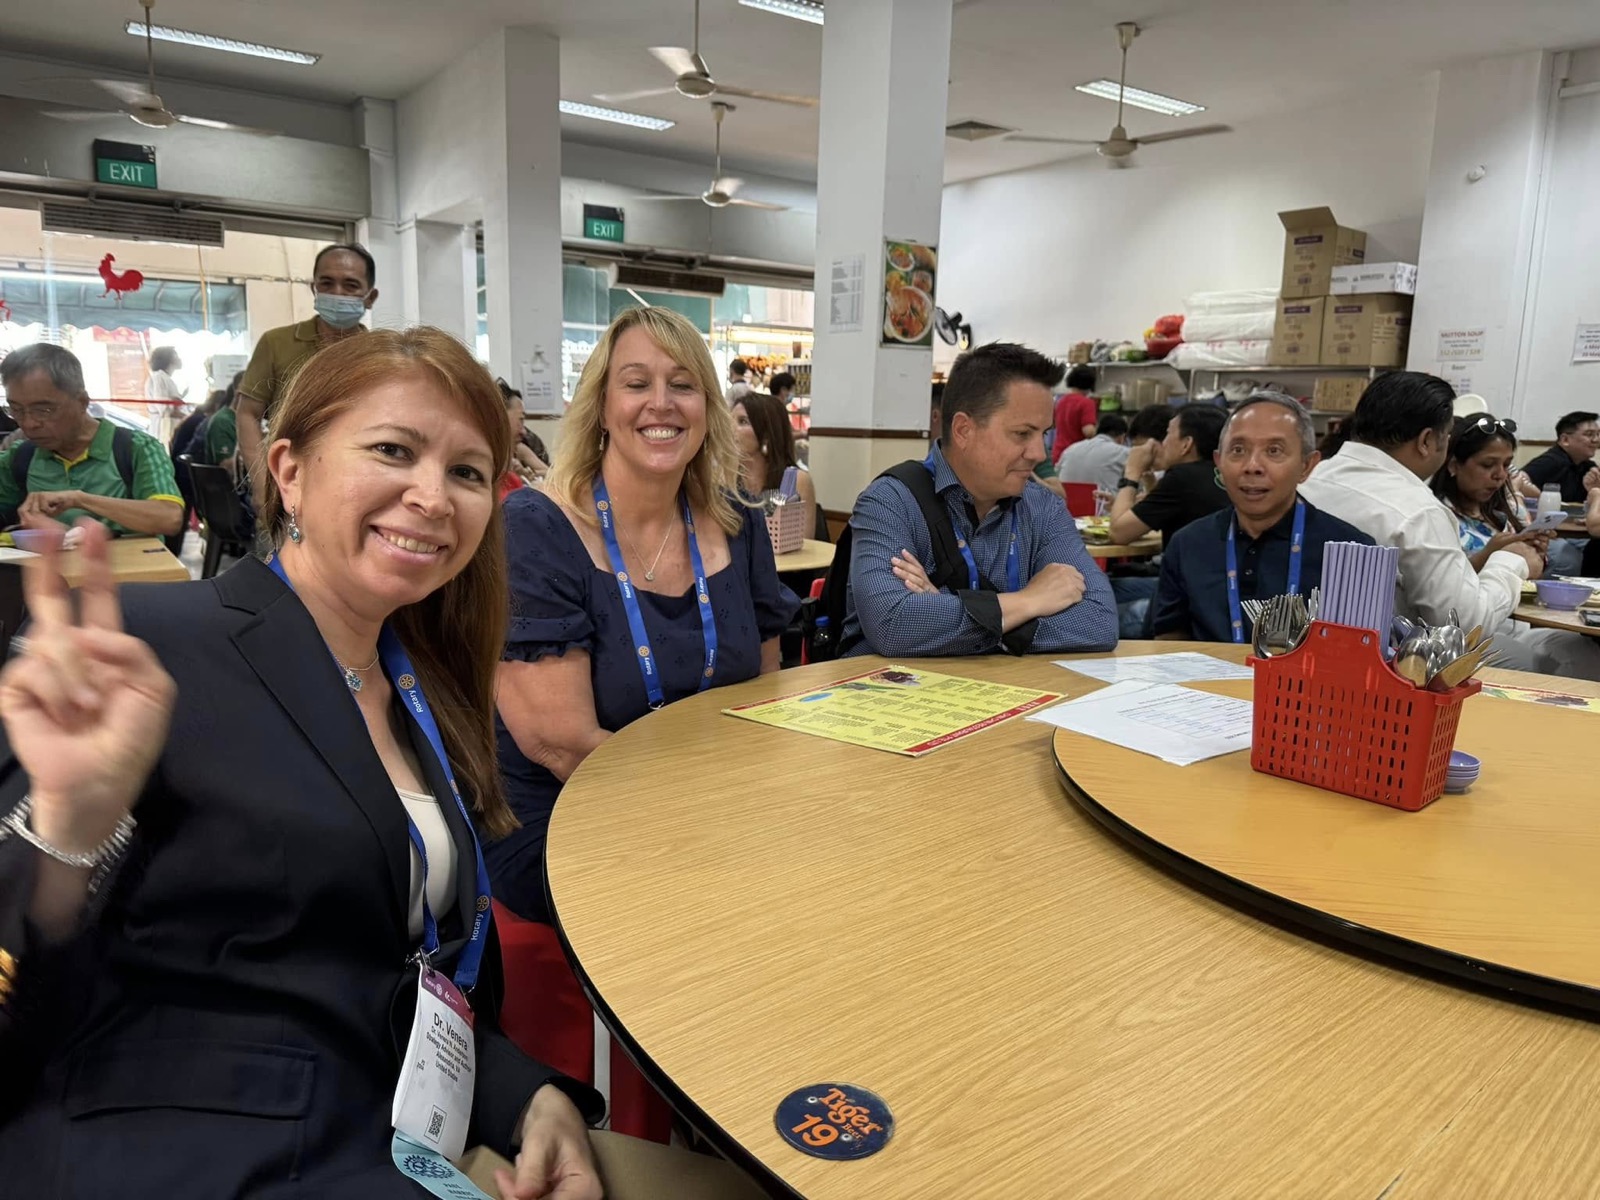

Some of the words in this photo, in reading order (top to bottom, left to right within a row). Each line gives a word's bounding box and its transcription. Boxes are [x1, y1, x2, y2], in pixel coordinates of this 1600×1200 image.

[109, 163, 144, 182] EXIT
[593, 221, 616, 238] EXIT
[602, 511, 610, 529] Rotary
[623, 582, 632, 599] Rotary
[698, 576, 706, 593] Rotary
[644, 657, 653, 676] Rotary
[408, 689, 424, 714] Rotary
[470, 913, 484, 941] Rotary
[434, 1012, 445, 1031] Dr.
[446, 1022, 468, 1051] Venera
[819, 1087, 884, 1135] Tiger
[792, 1113, 839, 1147] 19
[841, 1123, 864, 1140] Beer
